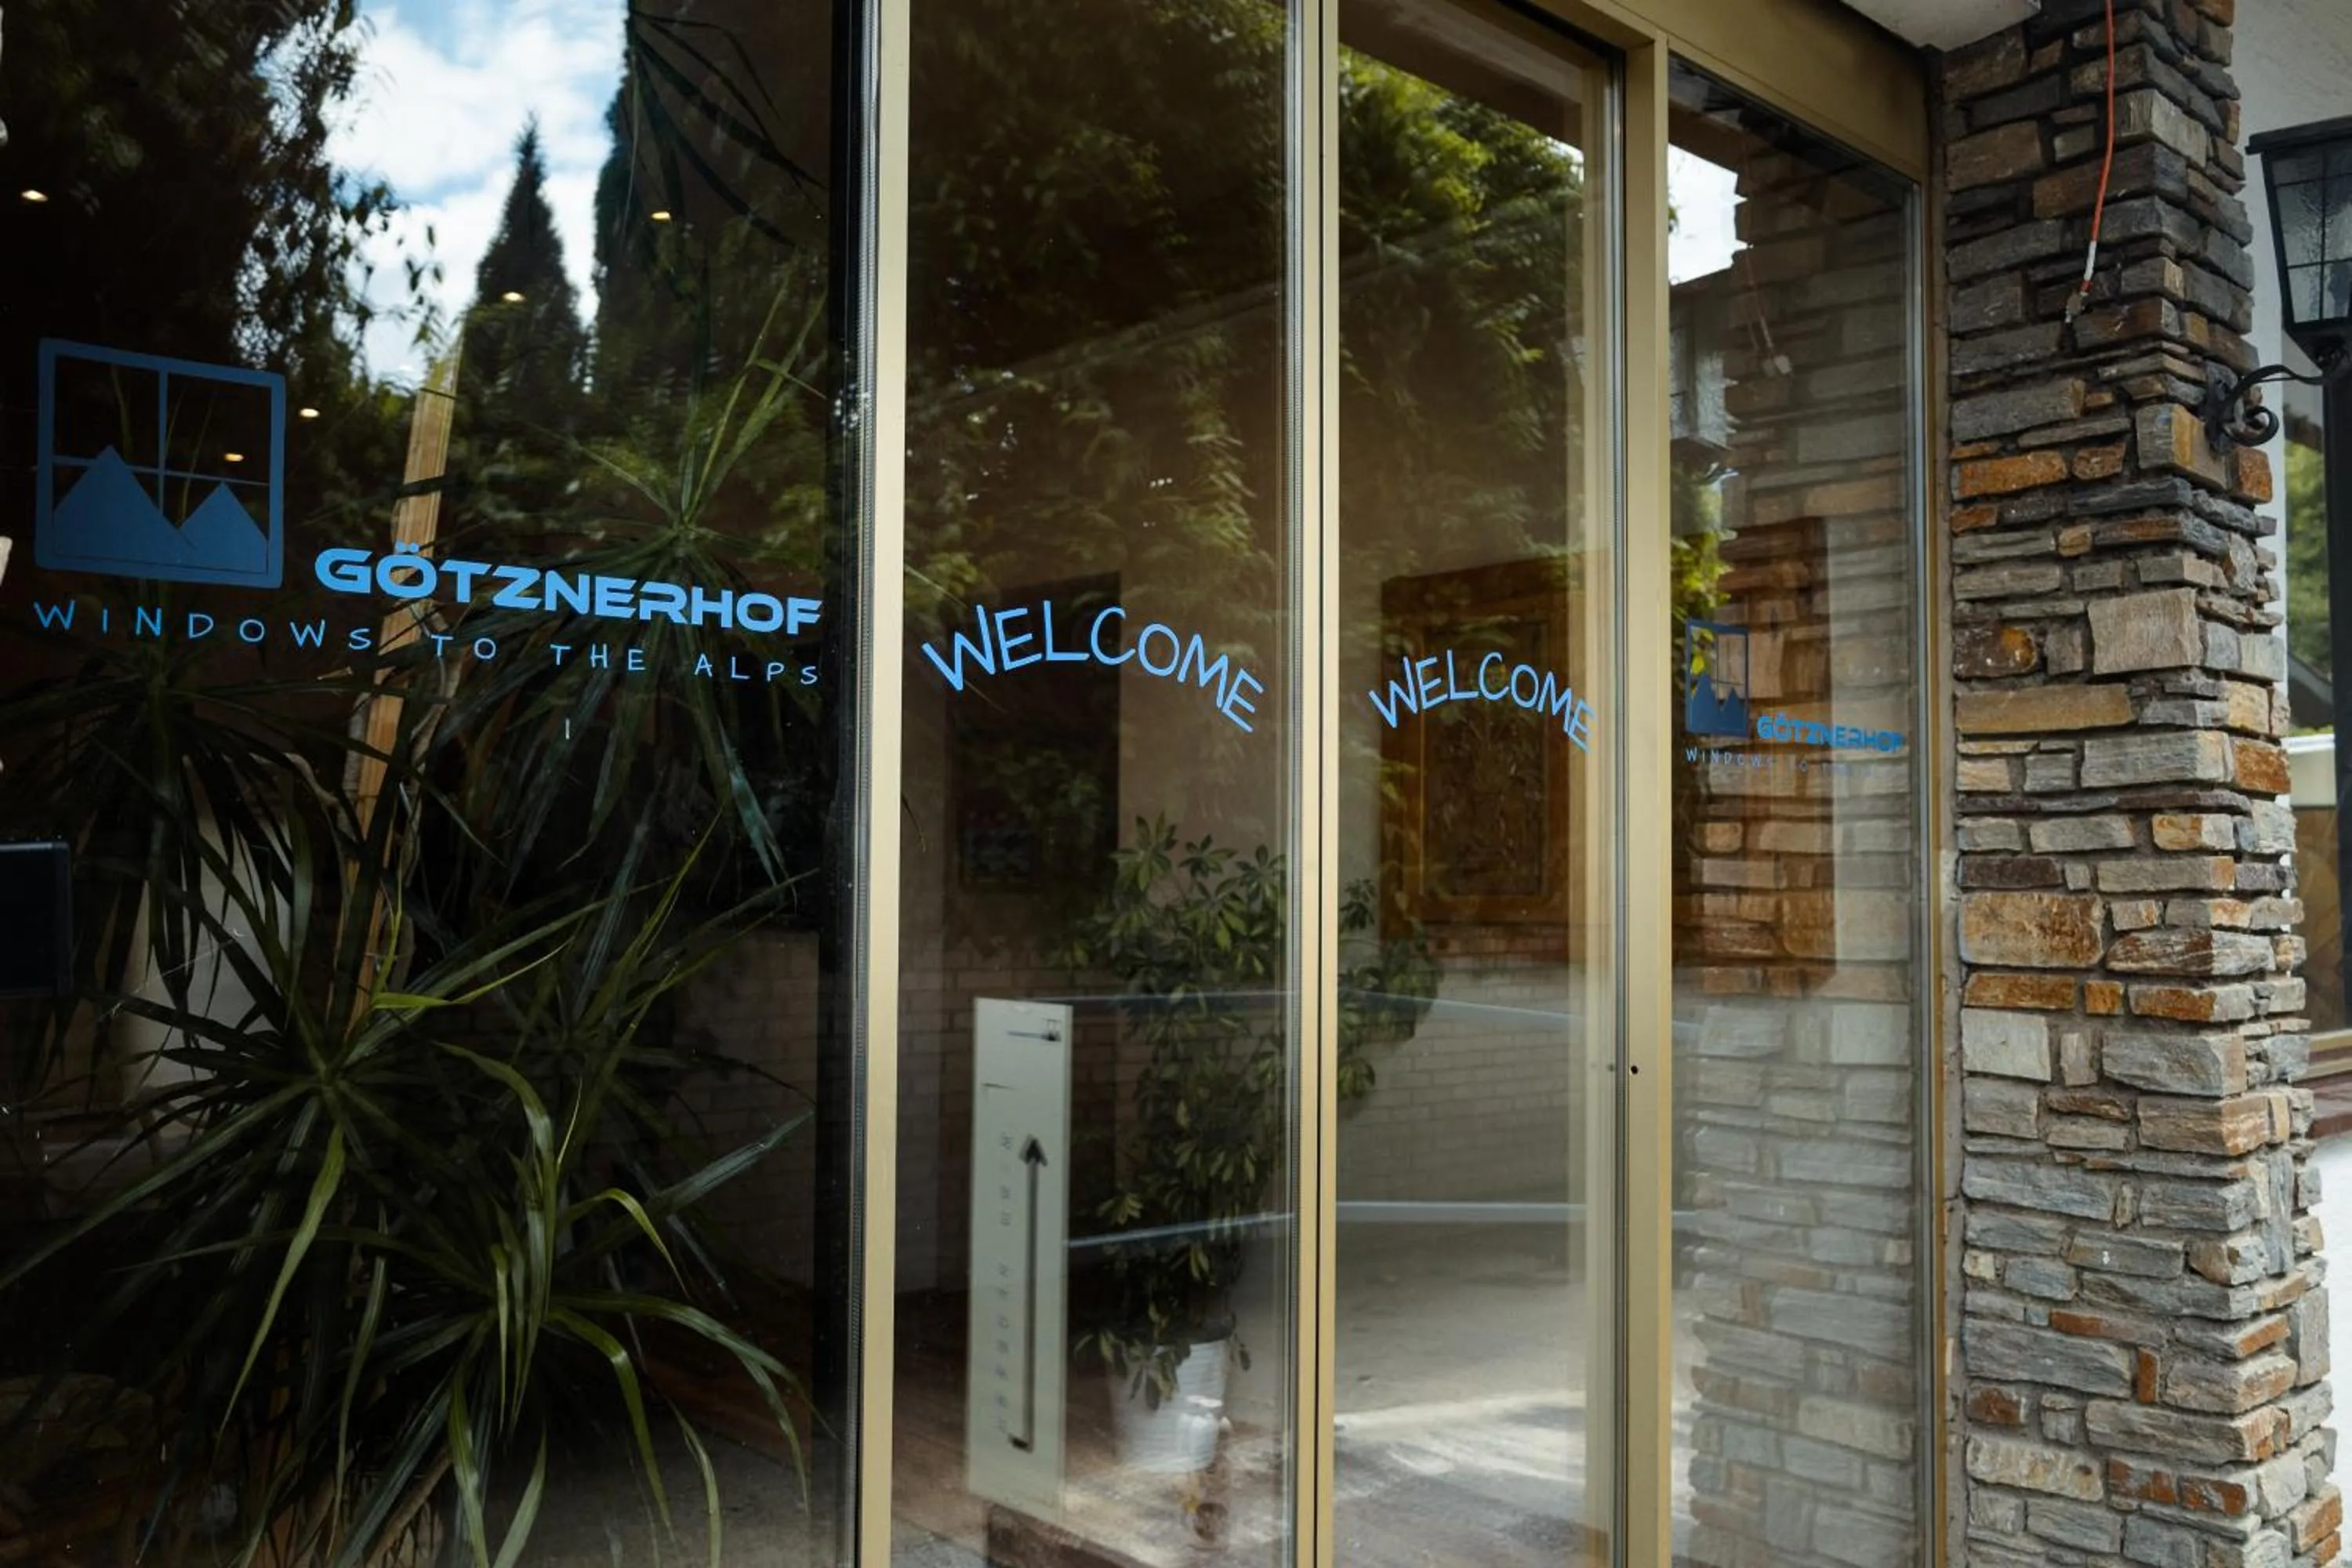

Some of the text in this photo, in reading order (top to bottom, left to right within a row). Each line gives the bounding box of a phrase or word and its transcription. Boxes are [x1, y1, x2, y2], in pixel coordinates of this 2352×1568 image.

[314, 541, 822, 635] GÖTZNERHOF
[34, 601, 818, 685] WINDOWS TO THE ALPS
[921, 600, 1264, 732] WELCOME
[1368, 649, 1598, 753] WELCOME
